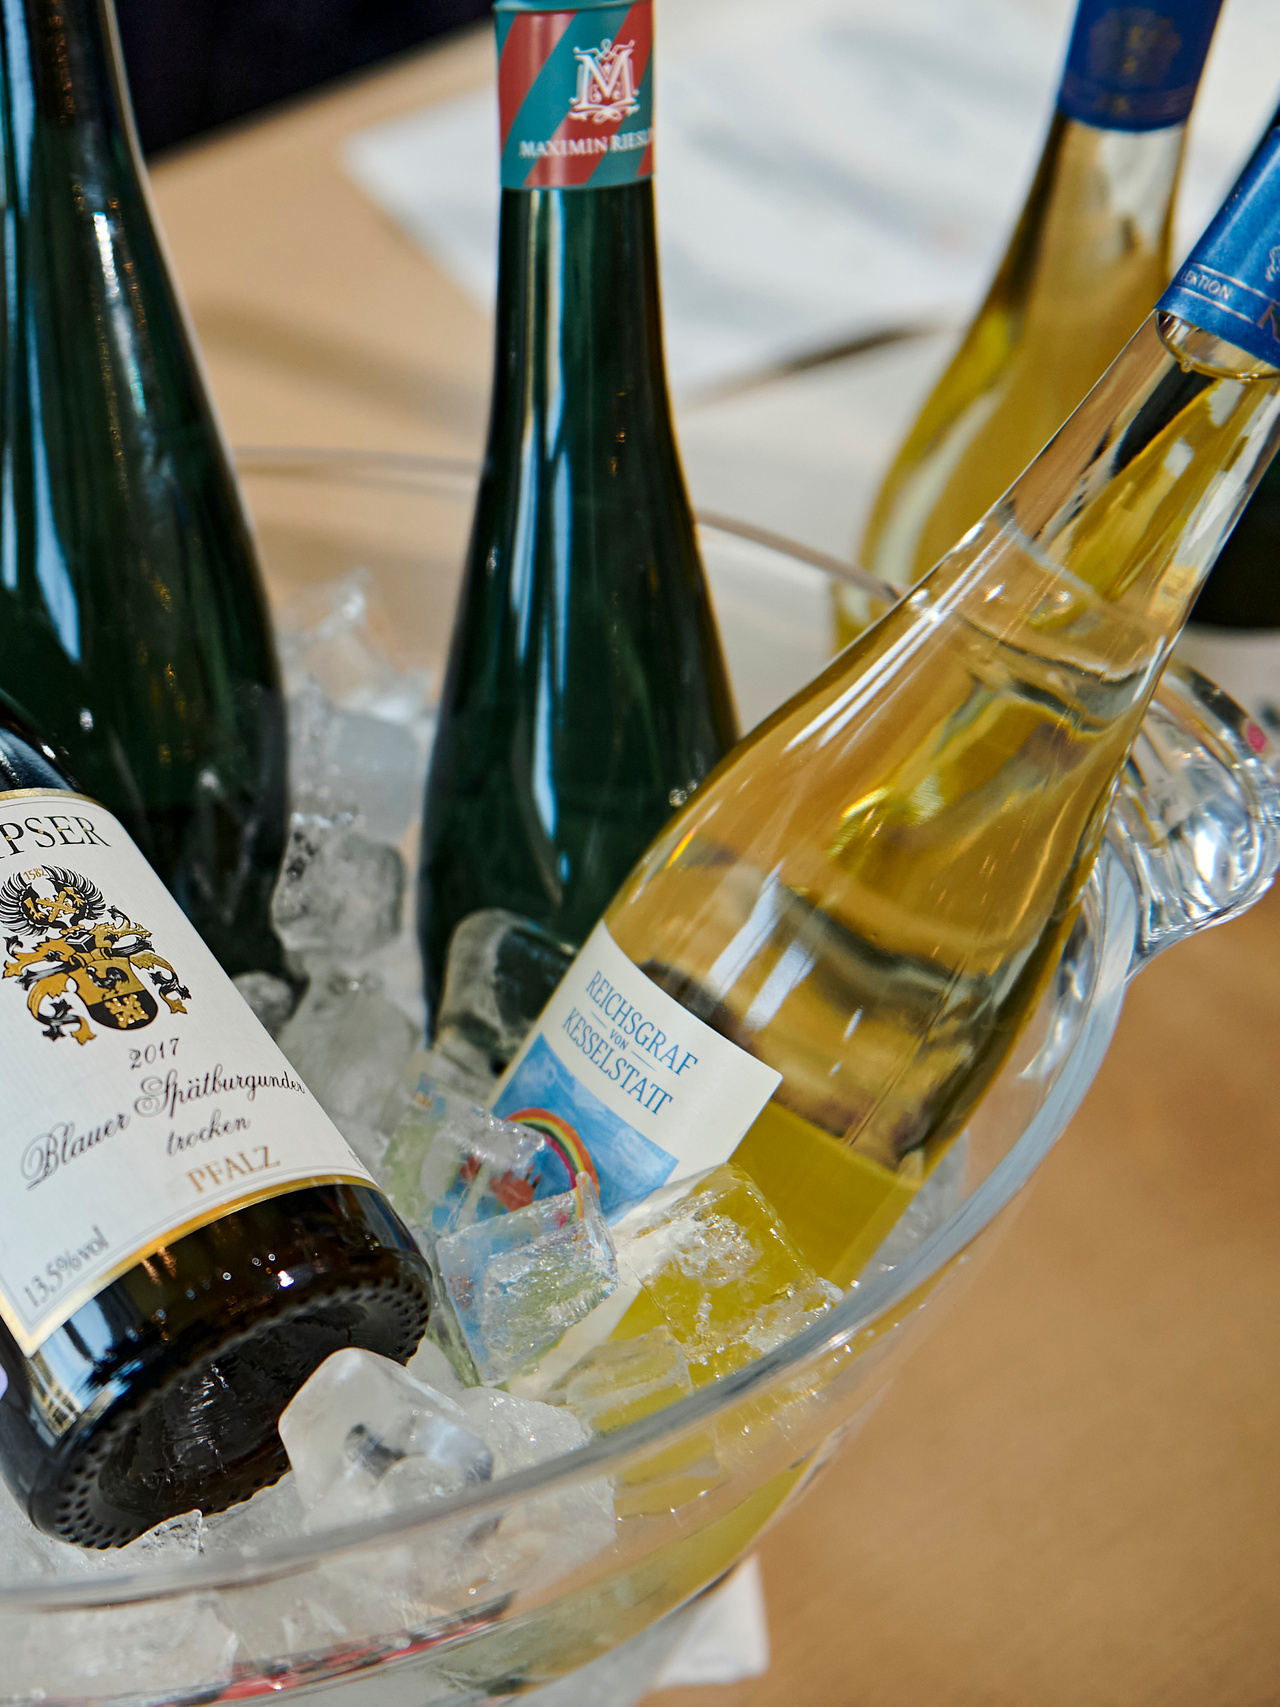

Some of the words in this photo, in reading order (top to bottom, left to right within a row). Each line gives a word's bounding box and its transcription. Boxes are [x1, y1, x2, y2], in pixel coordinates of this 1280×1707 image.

[519, 137, 607, 157] MAXIMIN
[23, 868, 48, 881] 1582
[586, 970, 698, 1076] REICHSGRAF
[609, 1031, 629, 1050] VON
[129, 1037, 179, 1070] 2017
[562, 1007, 673, 1115] KESSELSTATT
[20, 1111, 130, 1190] Blauer
[134, 1064, 305, 1118] Spätburgunder
[166, 1108, 251, 1156] trocken
[186, 1145, 280, 1193] PFALZ
